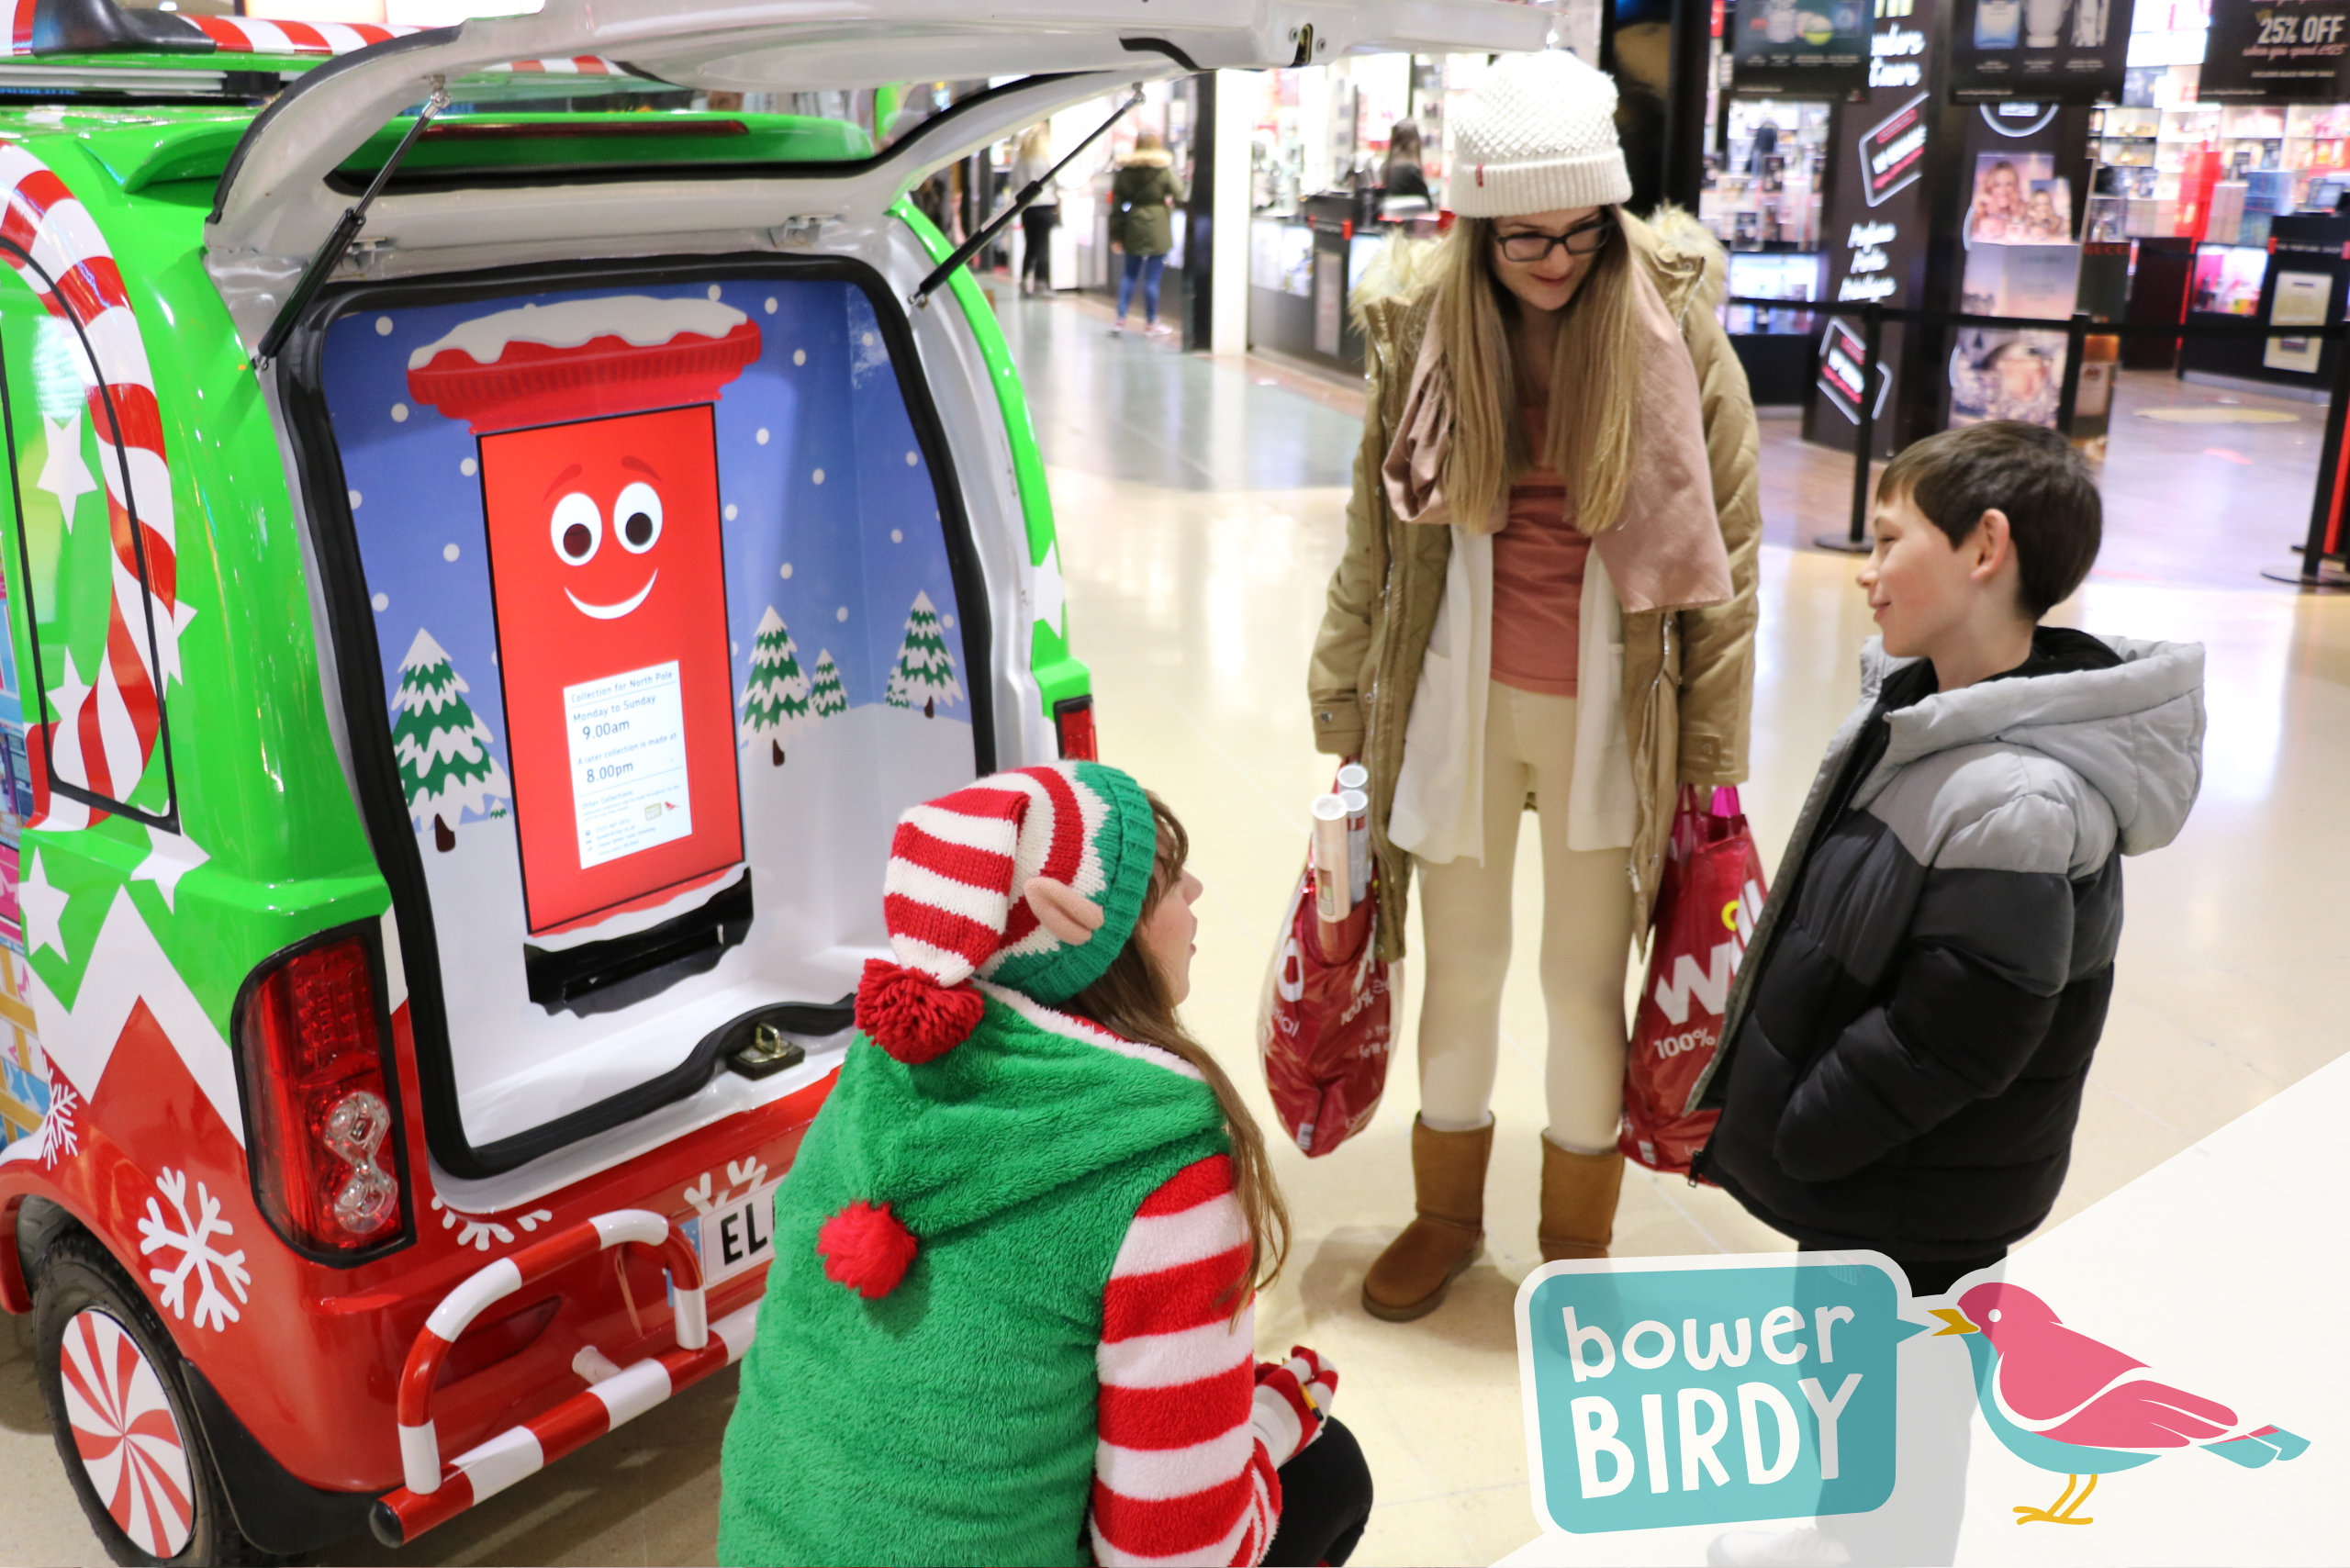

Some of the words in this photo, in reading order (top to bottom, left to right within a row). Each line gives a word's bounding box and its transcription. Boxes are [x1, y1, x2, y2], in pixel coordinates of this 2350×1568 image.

[2257, 17, 2299, 44] 25%
[2301, 15, 2346, 44] OFF
[571, 687, 612, 703] Collection
[614, 683, 626, 692] for
[630, 676, 653, 688] North
[655, 671, 673, 681] Pole
[573, 707, 609, 722] Monday
[611, 704, 621, 712] to
[623, 695, 656, 711] Sunday
[582, 721, 630, 741] 9.00am
[584, 753, 602, 764] later
[604, 744, 639, 758] collection
[640, 740, 646, 748] is
[648, 734, 667, 746] made
[669, 732, 677, 741] at
[587, 762, 633, 783] 8.00pm
[1654, 1026, 1716, 1060] 100%
[721, 1195, 777, 1265] EL
